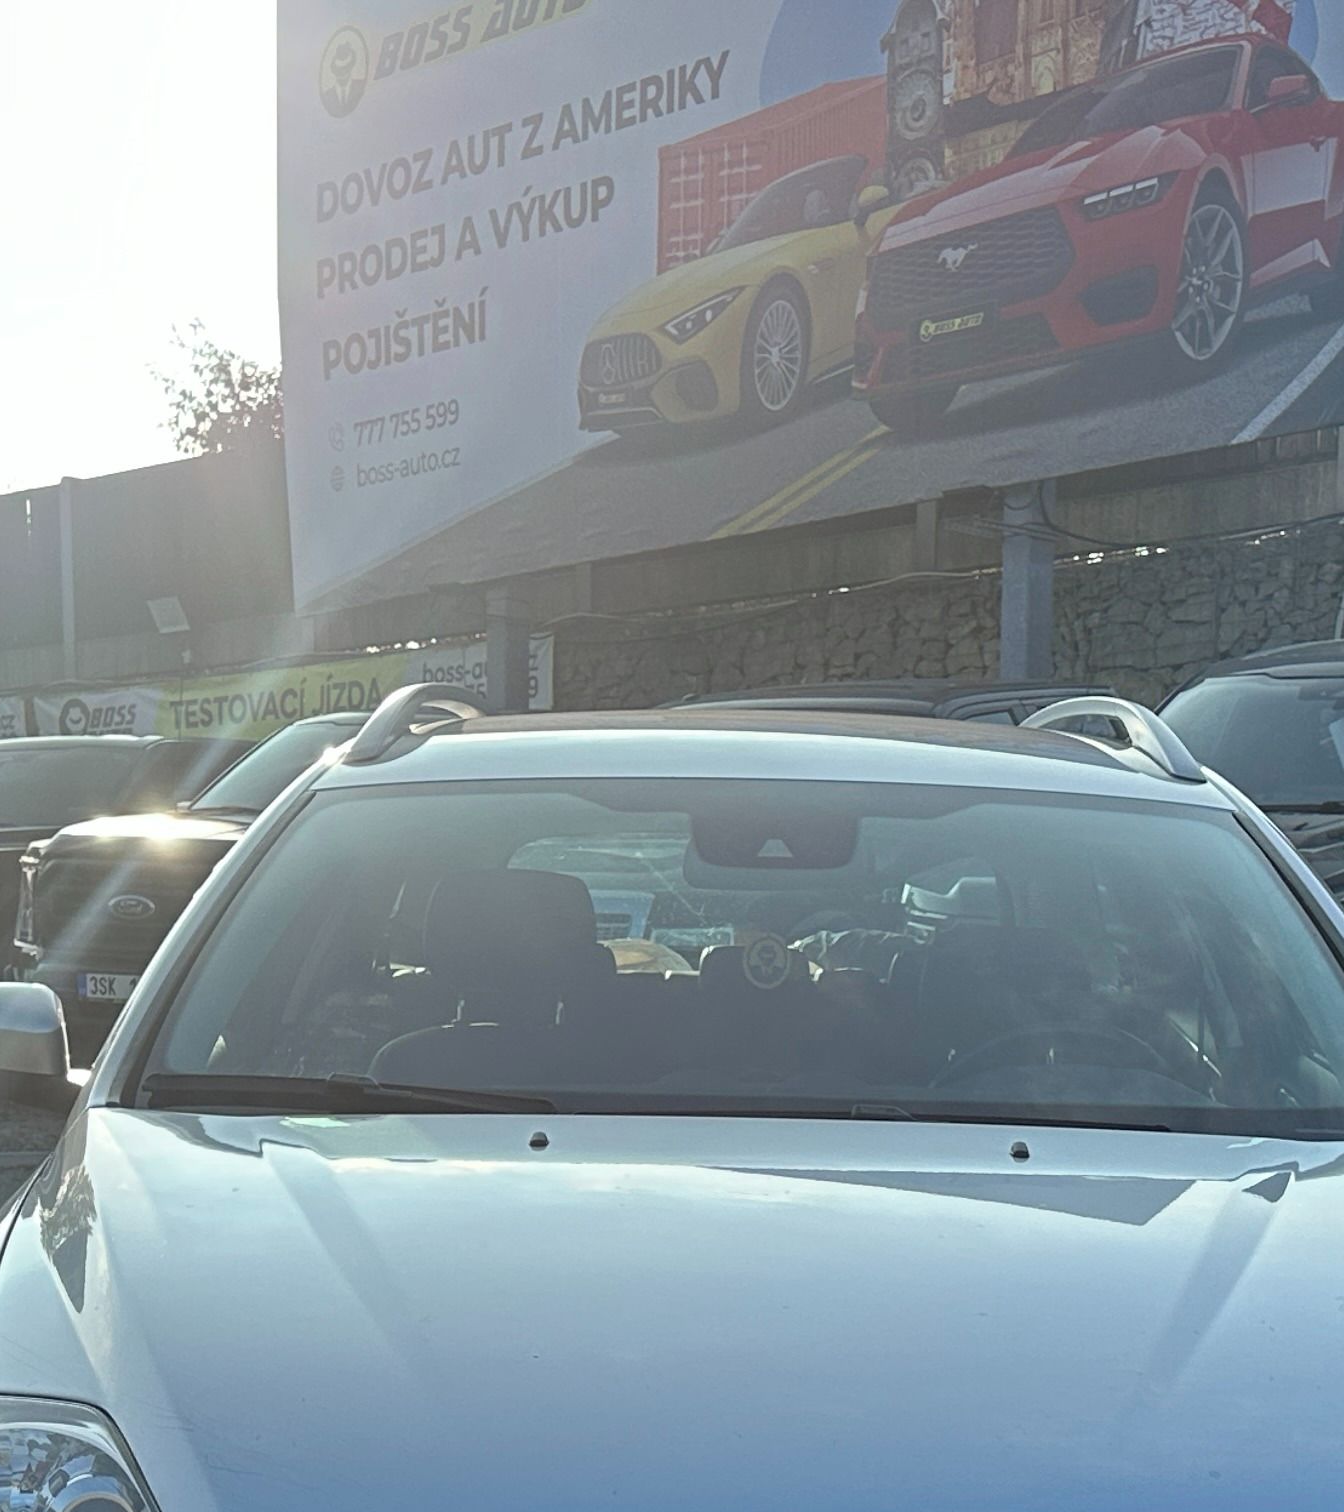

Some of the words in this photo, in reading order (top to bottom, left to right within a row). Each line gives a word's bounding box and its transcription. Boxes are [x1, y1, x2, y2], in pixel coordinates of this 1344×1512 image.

[373, 6, 473, 80] BOSS
[479, 0, 588, 43] AU
[316, 148, 434, 223] DOVOZ
[440, 121, 513, 186] AUT
[520, 112, 544, 160] Z
[551, 50, 731, 152] AMERIKY
[316, 223, 446, 299] PRODEJ
[455, 215, 482, 261] A
[488, 175, 615, 249] VÝKUP
[322, 286, 489, 381] POJIŠTĚNÍ
[353, 416, 386, 447] 777
[390, 408, 421, 438] 755
[425, 399, 460, 429] 599
[356, 447, 461, 487] boss-auto.cz
[89, 703, 137, 729] BOSS
[169, 679, 305, 730] TESTOVACÍ
[311, 673, 383, 715] JÍZDA
[89, 975, 117, 996] 3SK
